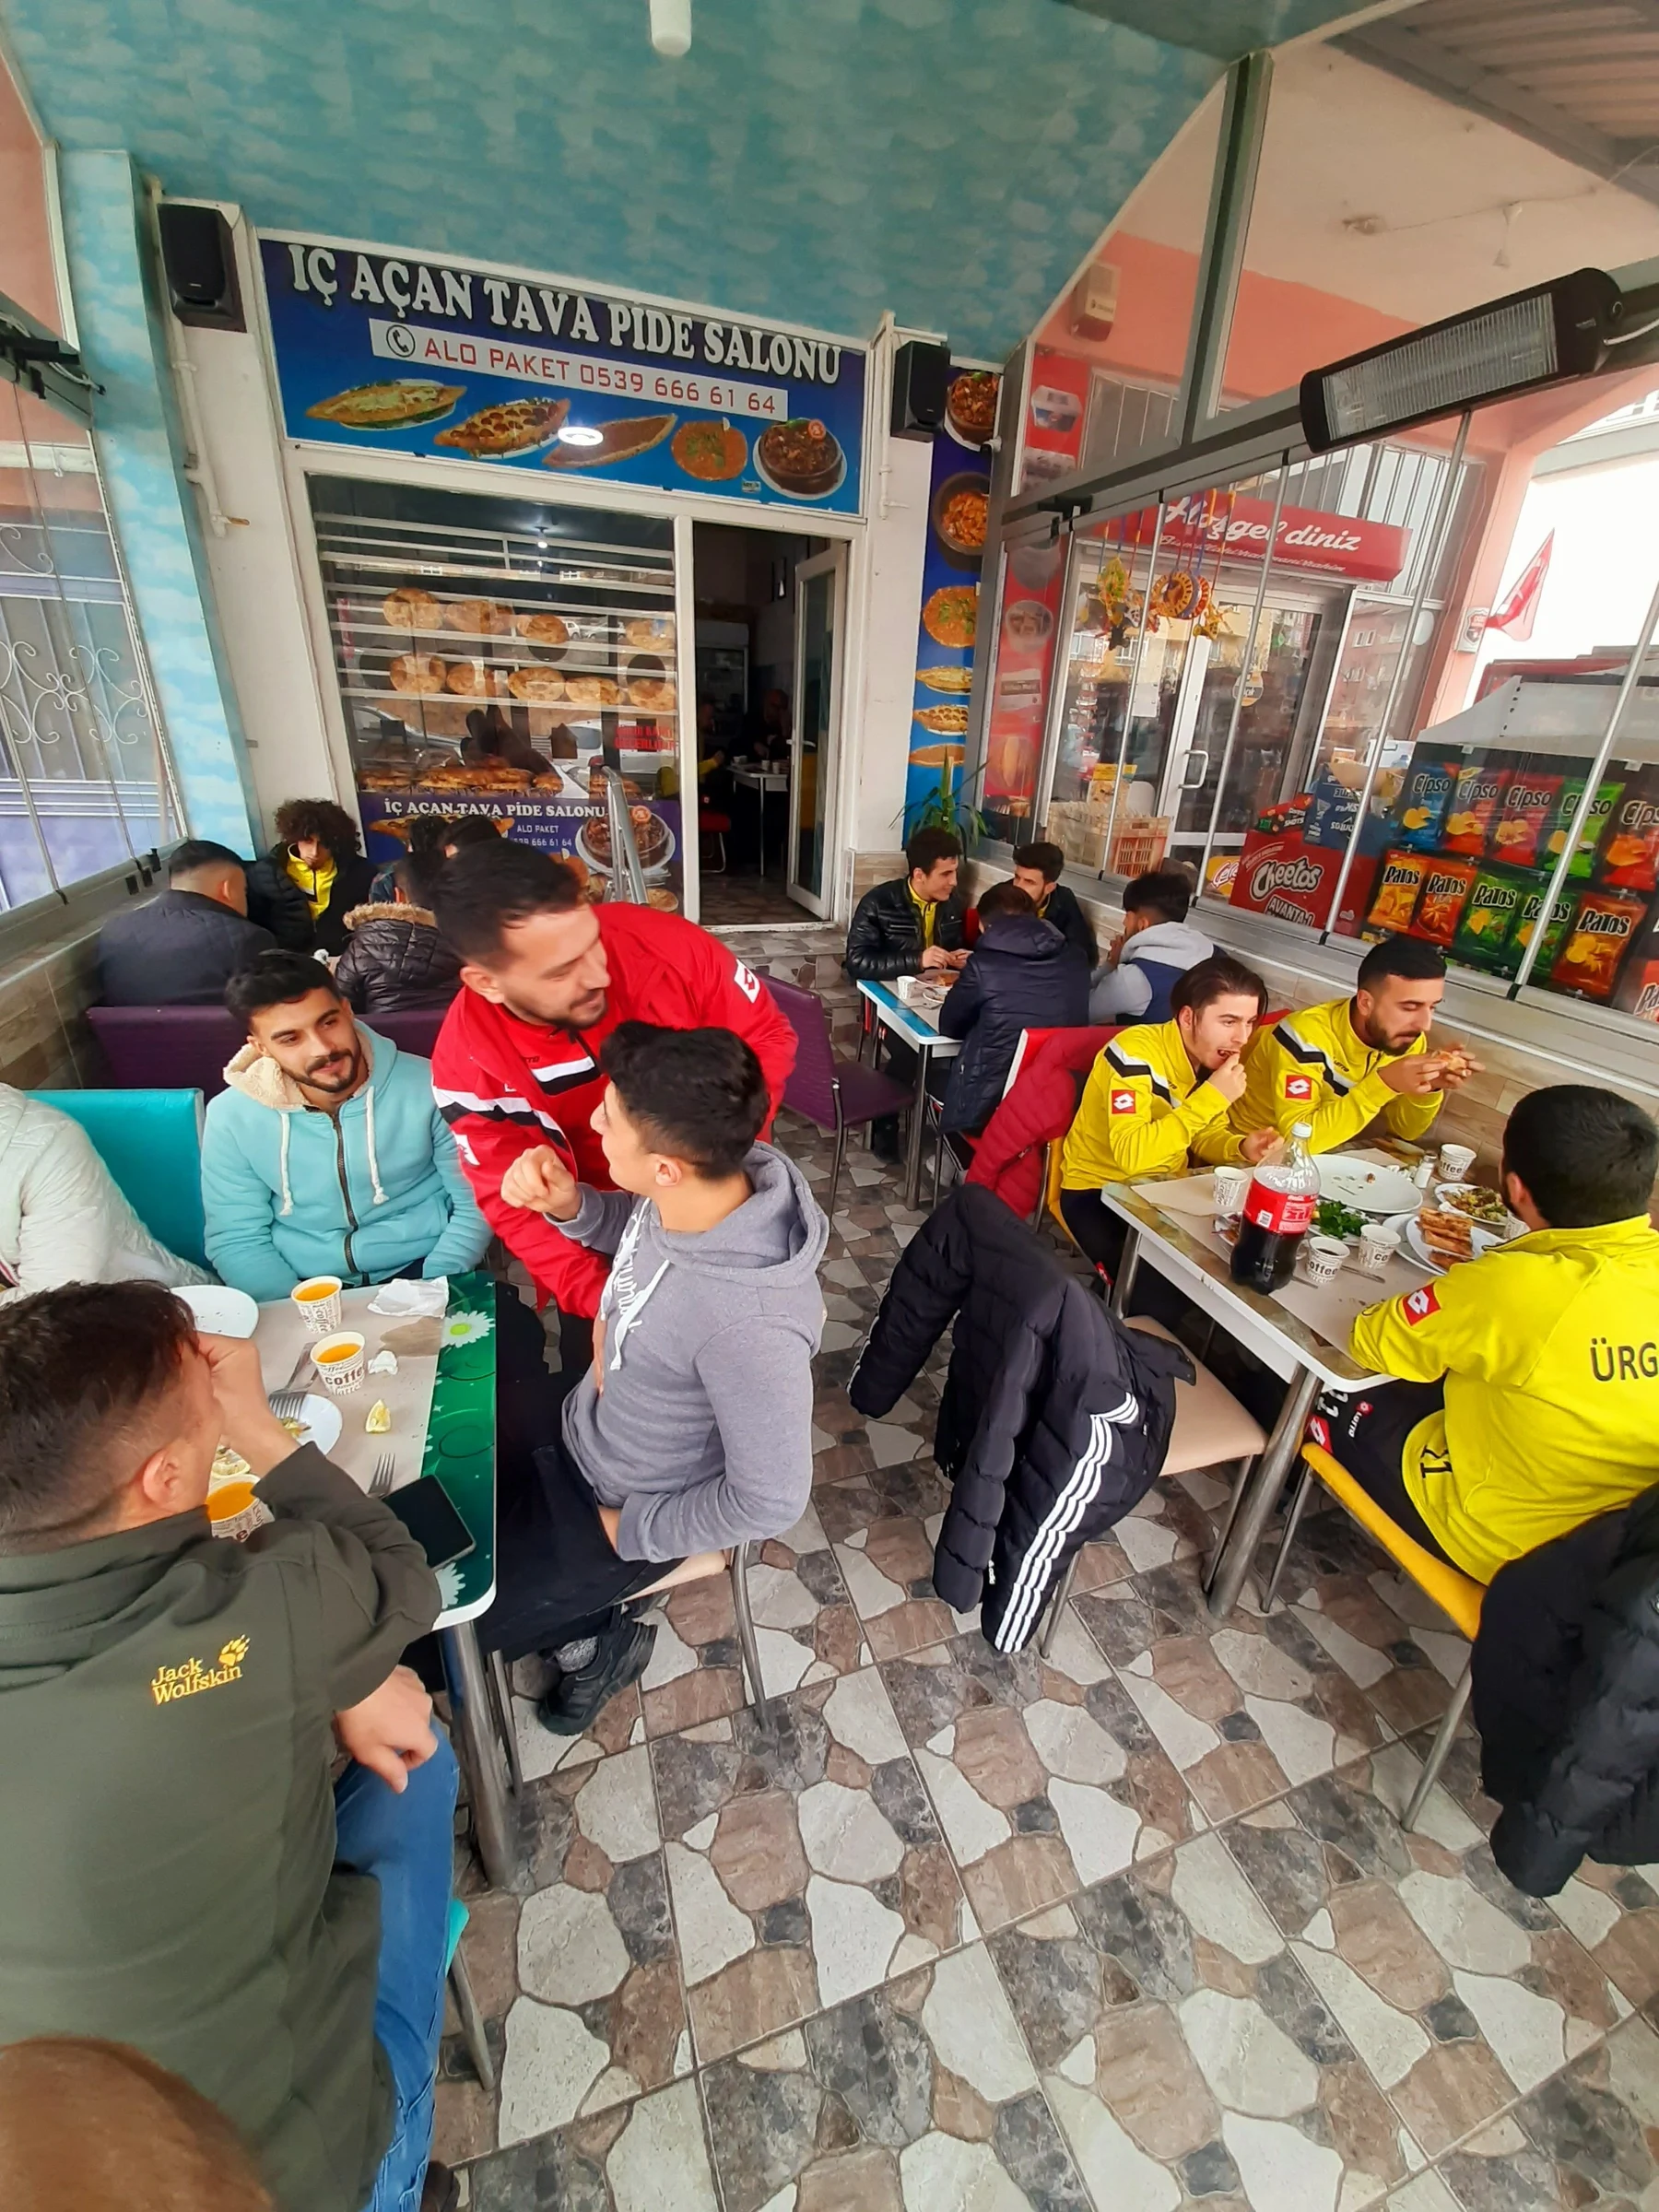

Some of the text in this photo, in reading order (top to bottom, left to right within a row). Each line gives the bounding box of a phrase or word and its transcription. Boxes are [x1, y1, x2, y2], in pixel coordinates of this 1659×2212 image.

[351, 254, 472, 320] AÇAN
[484, 278, 599, 343] TAVA
[704, 322, 841, 384] SALONU
[425, 337, 776, 414] ALO PAKET 0539 666 61 64
[384, 798, 403, 816] İÇ
[456, 803, 503, 816] TAVA
[506, 801, 543, 817] PİDE
[546, 805, 606, 818] SALONU
[517, 825, 559, 834] ALO PAKET
[532, 838, 547, 847] 666
[549, 838, 559, 847] 61
[562, 838, 572, 847] 64
[1251, 856, 1324, 900] Cheetos
[151, 1657, 204, 1687] Jack
[152, 1665, 243, 1705] Wolfskin
